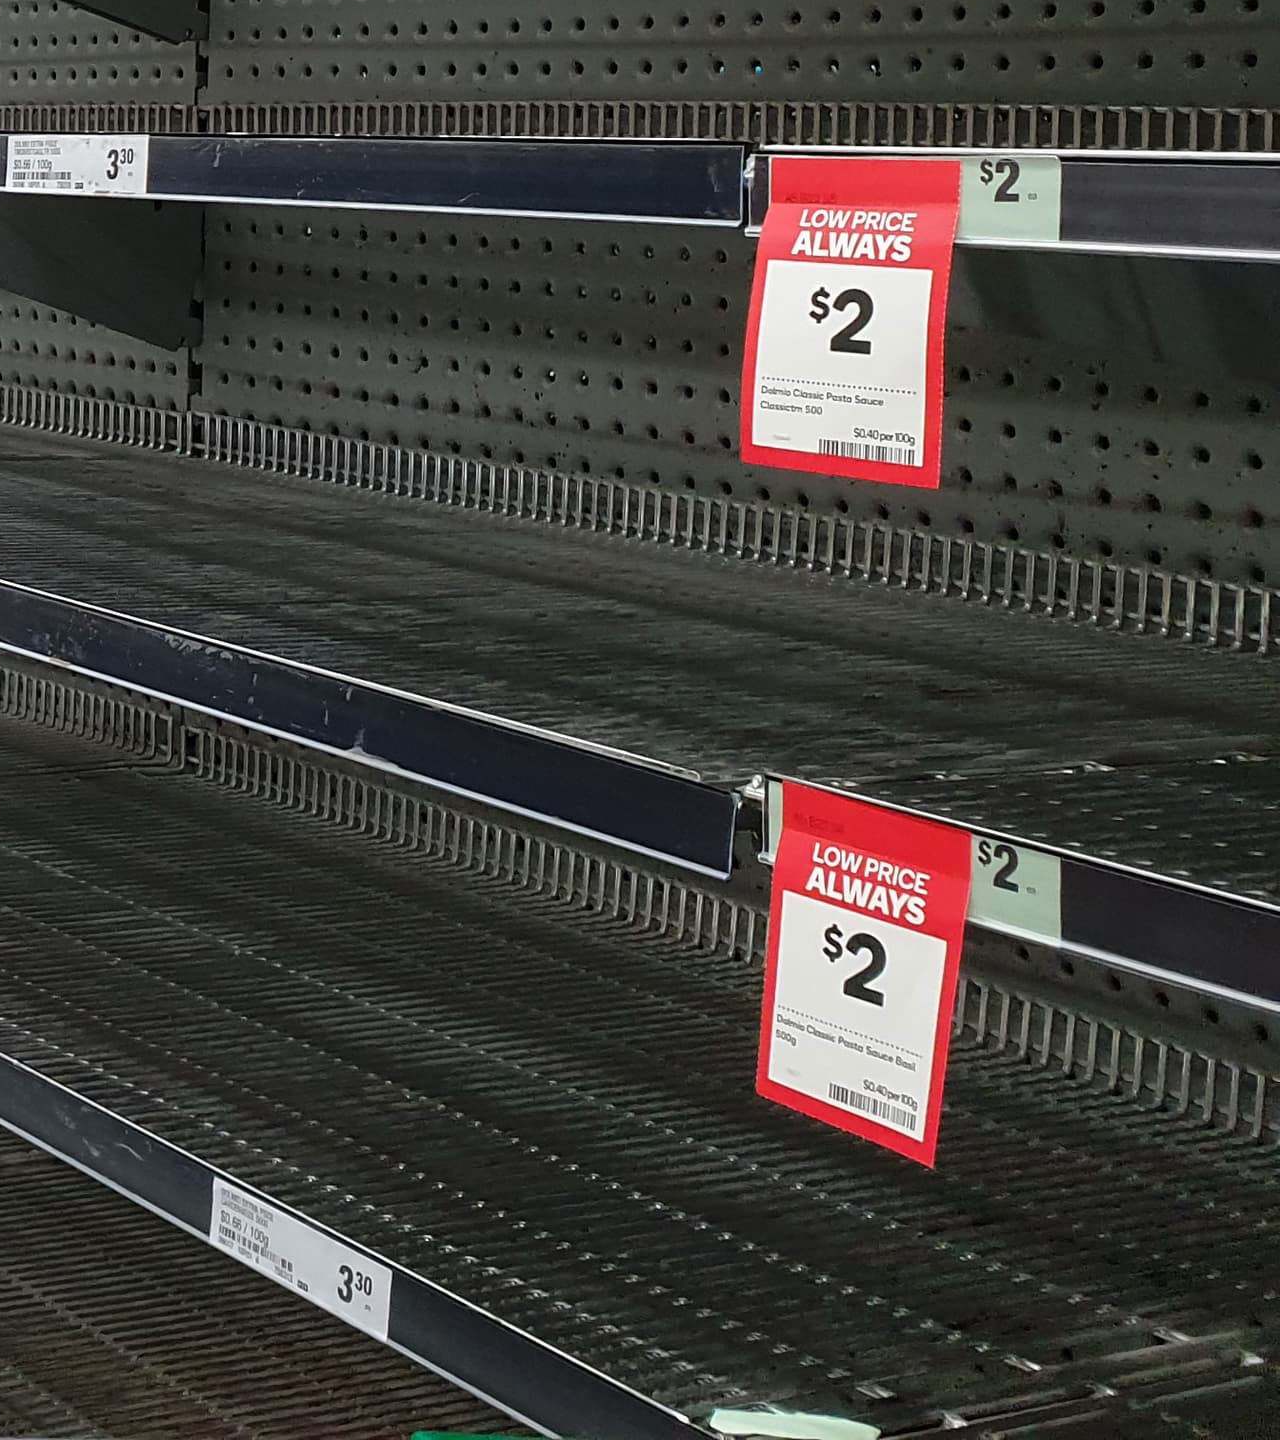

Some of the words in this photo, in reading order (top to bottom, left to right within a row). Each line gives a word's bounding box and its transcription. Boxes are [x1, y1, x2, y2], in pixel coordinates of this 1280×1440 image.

[979, 158, 1020, 203] $2
[800, 209, 851, 228] LOW
[852, 211, 917, 232] PRICE
[791, 231, 912, 262] ALWAYS
[809, 287, 874, 355] $2
[761, 385, 791, 397] Dolmio
[793, 389, 824, 400] Classic
[826, 392, 852, 404] Pasta
[854, 394, 884, 406] Sauce
[805, 405, 822, 415] 500
[853, 428, 879, 441] $0.40
[879, 432, 894, 444] per
[895, 432, 915, 446] 100g
[812, 842, 864, 873] LOW
[865, 858, 930, 896] PRICE
[977, 839, 1020, 893] $2
[805, 866, 926, 925] ALWAYS
[822, 924, 887, 1007] $2
[775, 1029, 797, 1047] 500g
[776, 1014, 805, 1032] Dolmio
[806, 1024, 835, 1043] Classic
[837, 1035, 864, 1053] Pasta
[865, 1045, 894, 1064] Sauce
[250, 1226, 269, 1248] 100g
